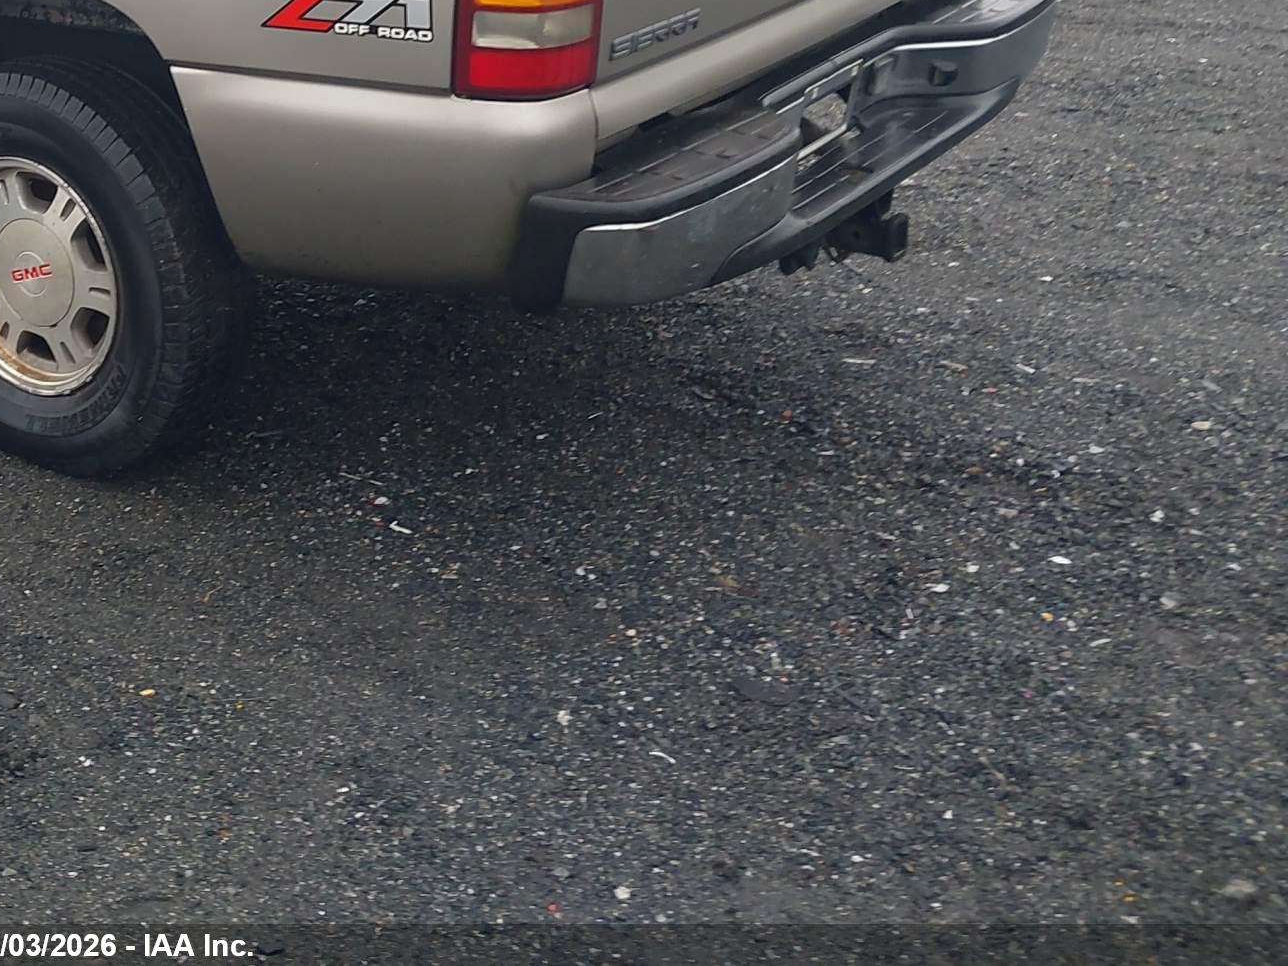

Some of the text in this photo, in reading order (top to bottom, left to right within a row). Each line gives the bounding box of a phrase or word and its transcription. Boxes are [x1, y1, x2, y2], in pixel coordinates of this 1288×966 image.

[334, 23, 433, 42] OFF ROAD
[609, 8, 701, 61] SIERRA
[11, 263, 53, 283] GMC
